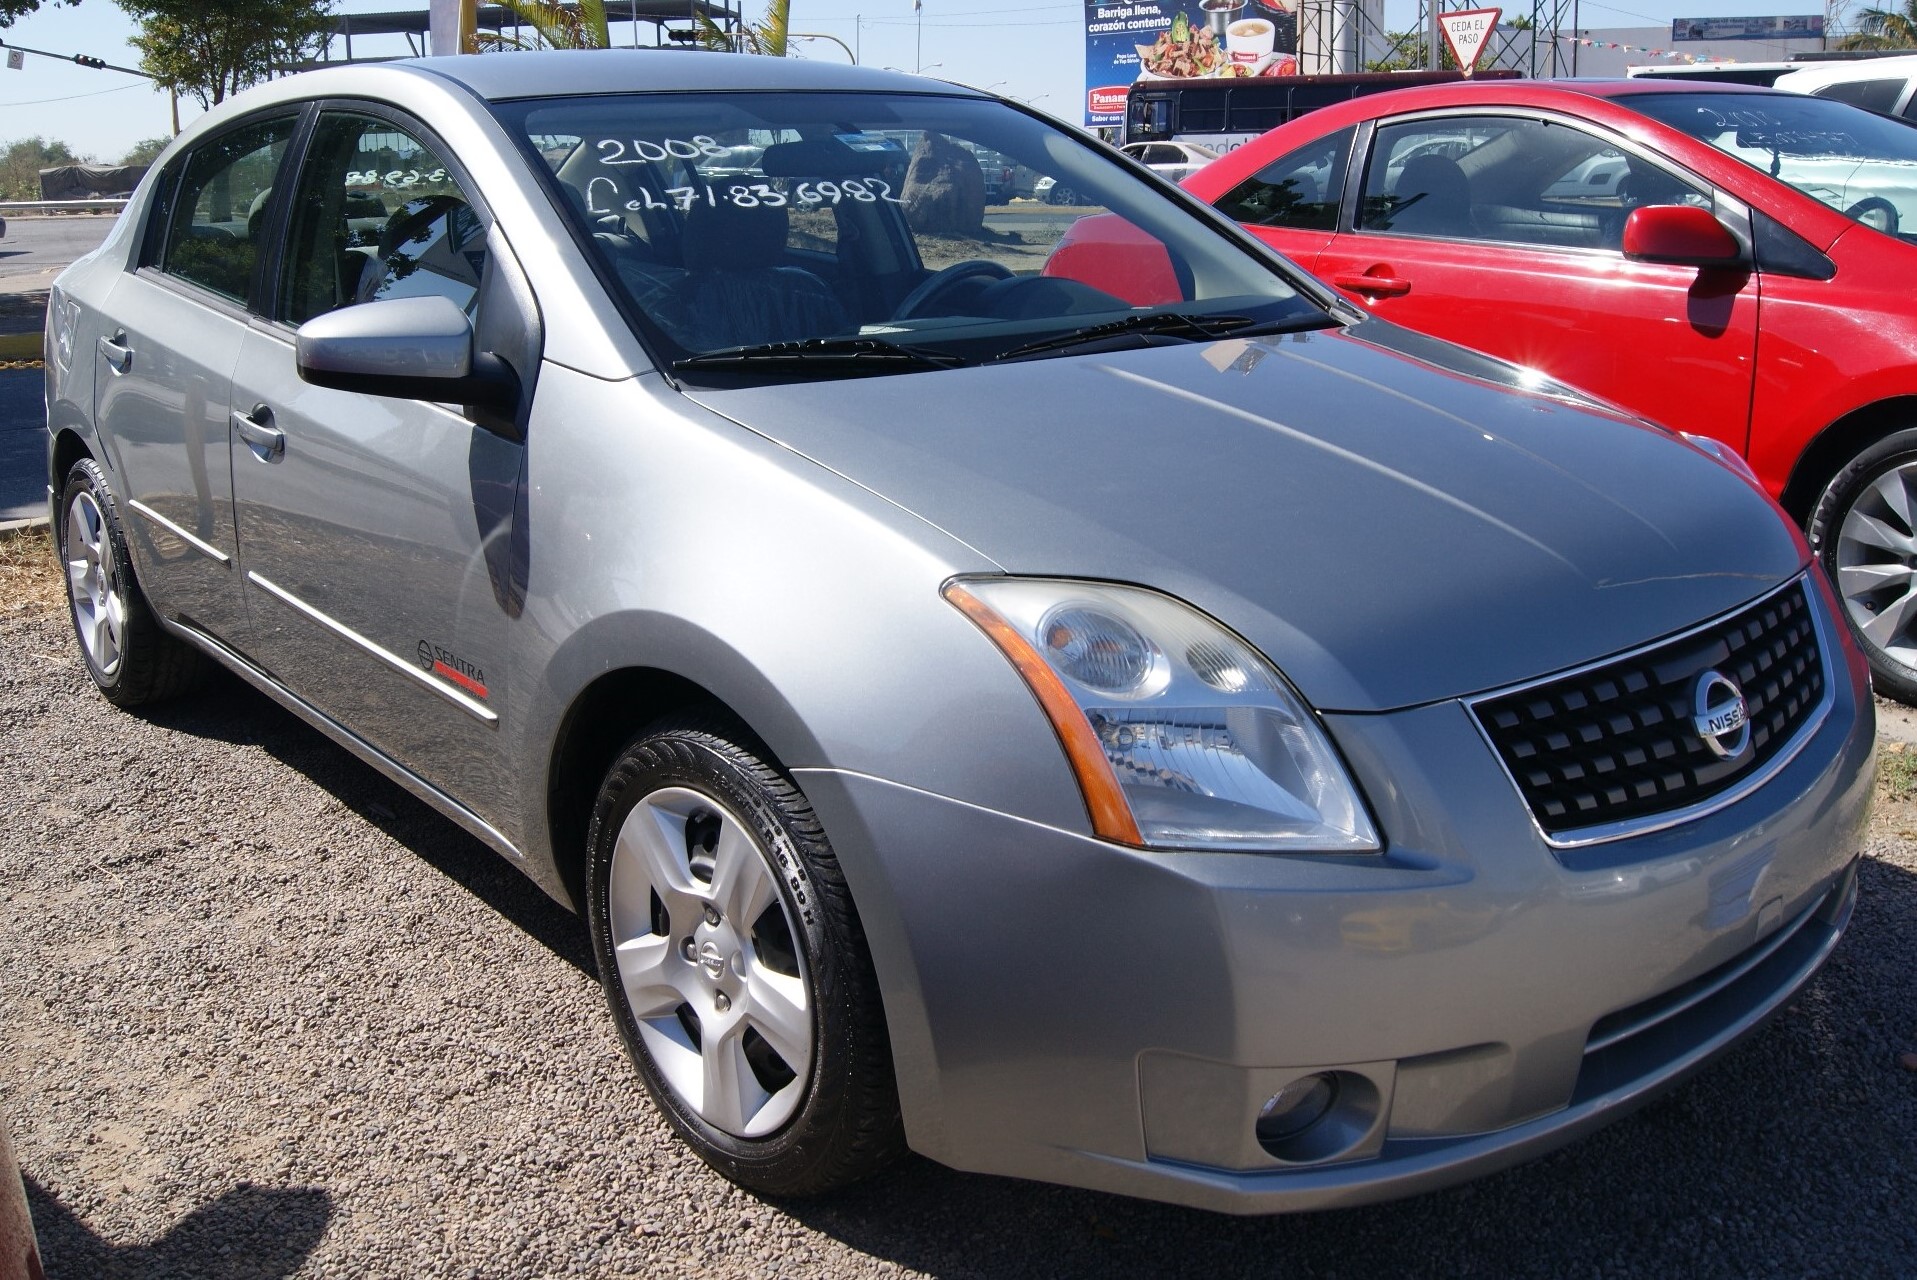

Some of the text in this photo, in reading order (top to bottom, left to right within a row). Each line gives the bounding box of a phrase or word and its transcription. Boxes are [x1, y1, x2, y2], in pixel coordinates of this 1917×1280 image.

[1097, 4, 1161, 19] Barriga llena,
[1088, 16, 1172, 32] corazón contento
[1451, 19, 1484, 32] CEDA EL
[1458, 33, 1479, 45] PASO
[1092, 93, 1128, 104] Panam
[597, 135, 732, 165] 2008
[434, 645, 486, 686] SENTRA
[1708, 702, 1746, 733] NISSA
[803, 909, 814, 926] H
